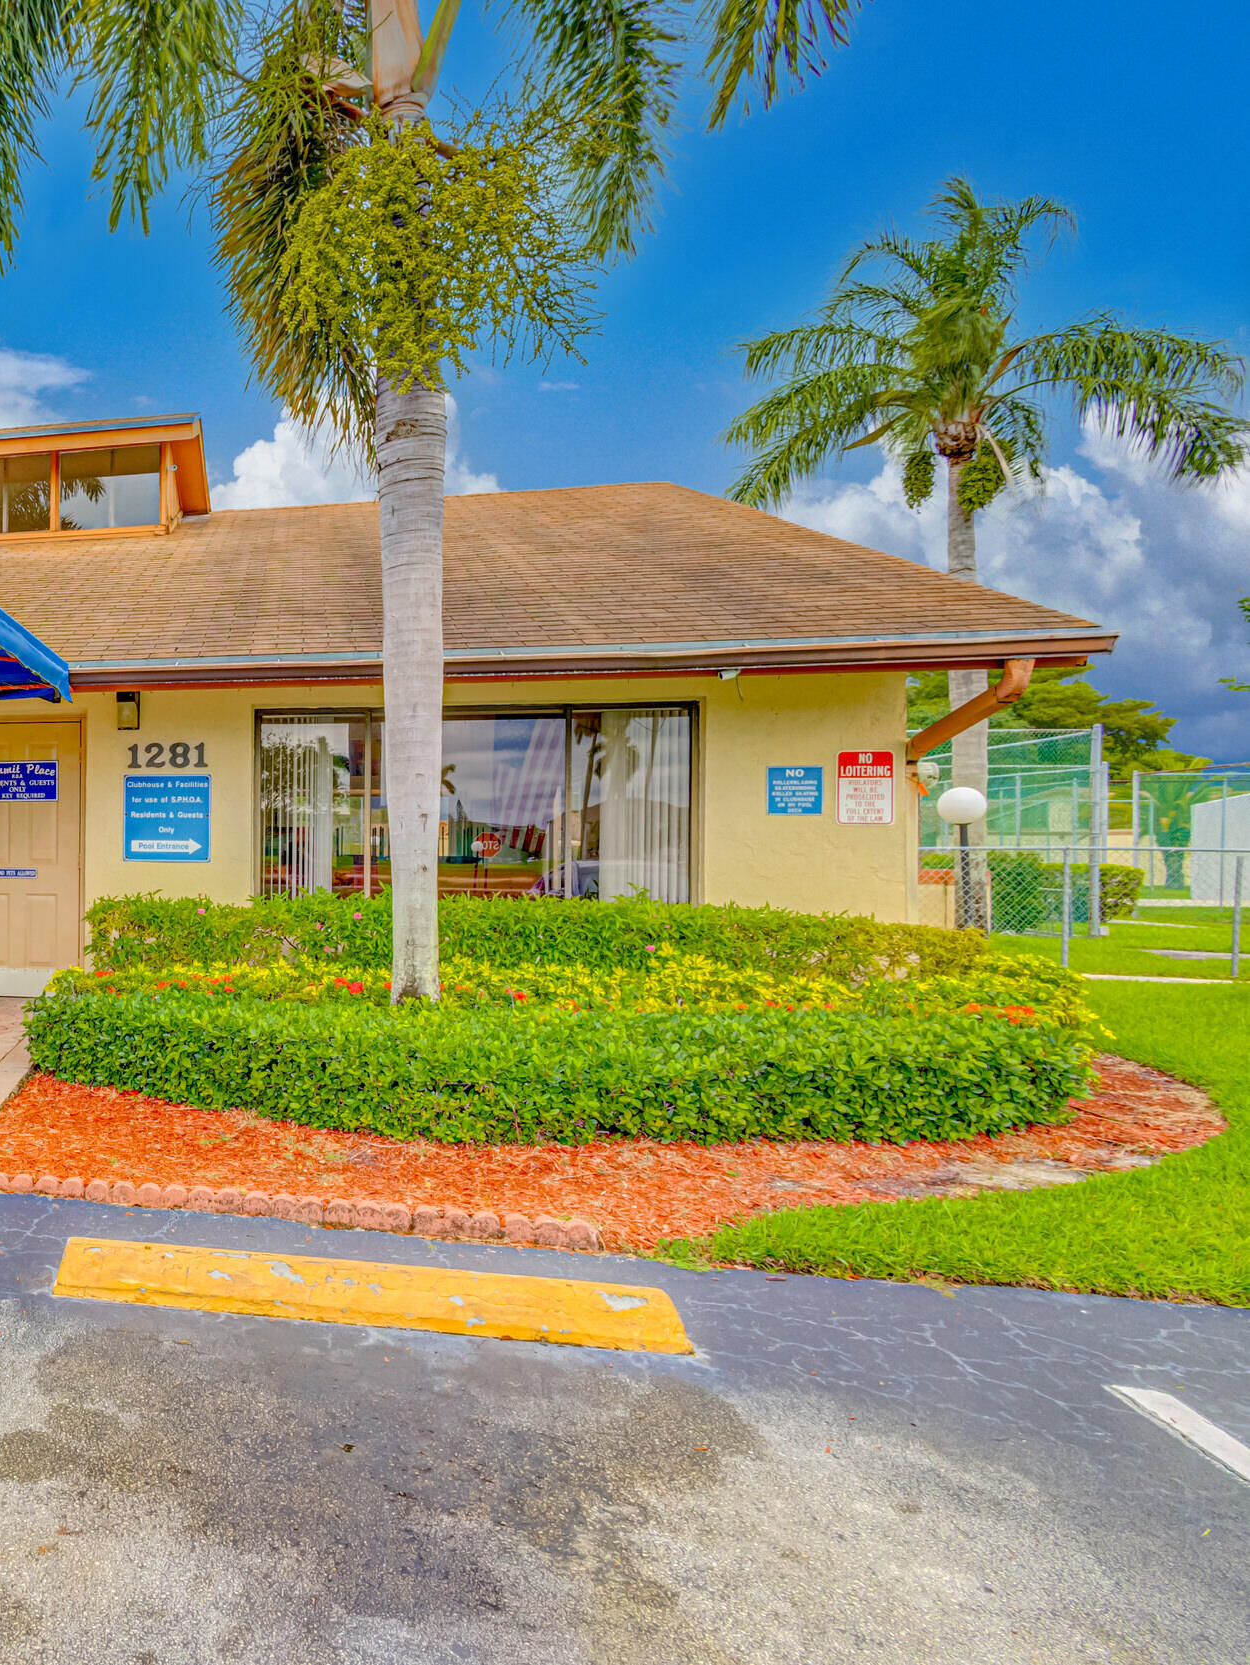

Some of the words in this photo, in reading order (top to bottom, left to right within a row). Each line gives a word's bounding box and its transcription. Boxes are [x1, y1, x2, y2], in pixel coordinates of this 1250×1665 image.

[127, 742, 208, 769] 1281
[858, 752, 873, 764] NO
[26, 763, 56, 777] Place
[785, 768, 805, 778] NO
[840, 765, 891, 777] LOITERING
[177, 811, 204, 819] Guests
[158, 826, 175, 835] Only
[156, 842, 189, 850] Entrance
